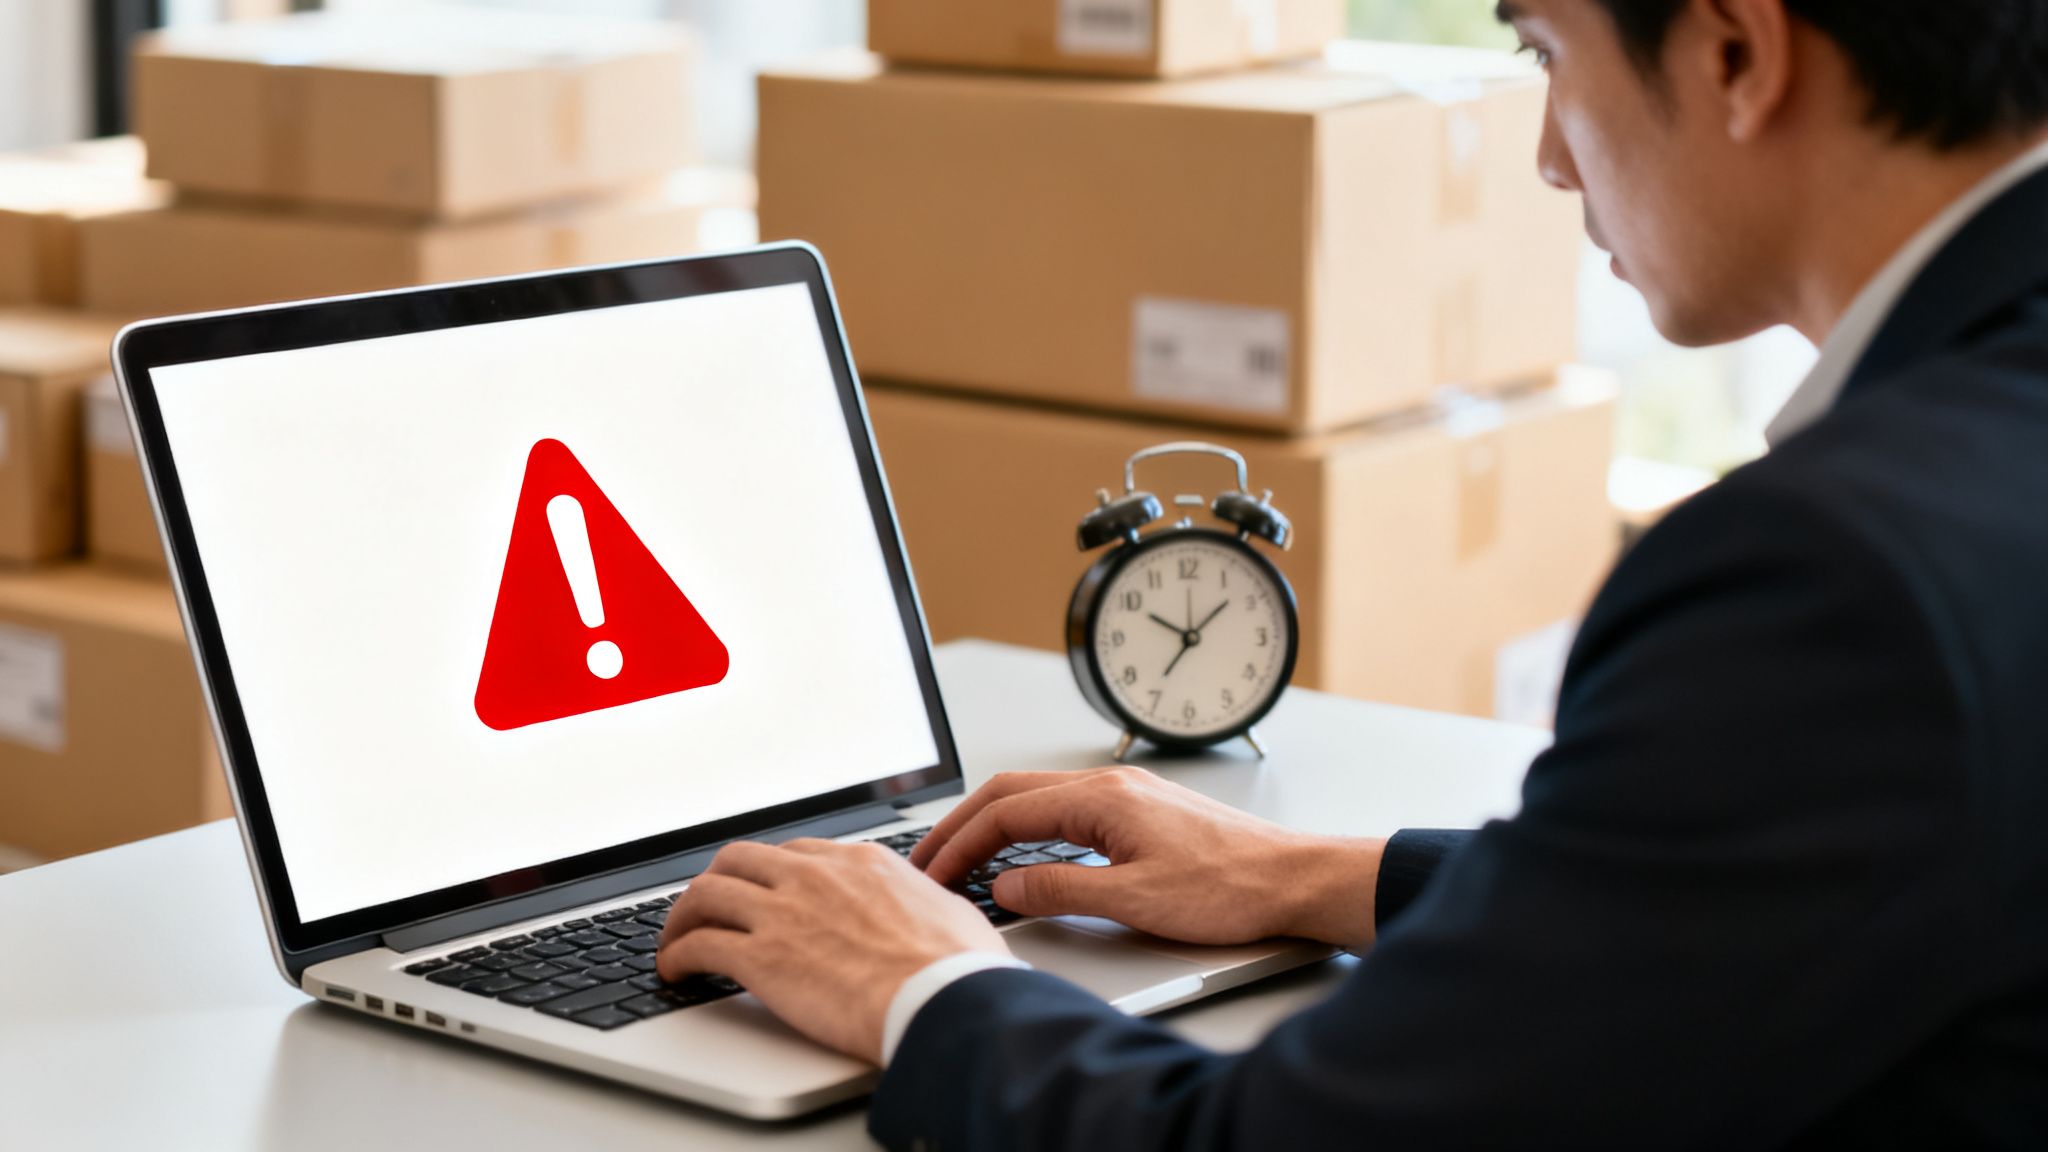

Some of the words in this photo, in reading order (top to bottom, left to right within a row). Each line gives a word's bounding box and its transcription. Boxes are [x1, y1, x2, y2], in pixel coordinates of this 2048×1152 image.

[1178, 558, 1199, 580] 12
[1221, 569, 1227, 589] 1
[1119, 590, 1143, 611] 10
[1256, 626, 1267, 647] 3
[1148, 690, 1162, 716] 7
